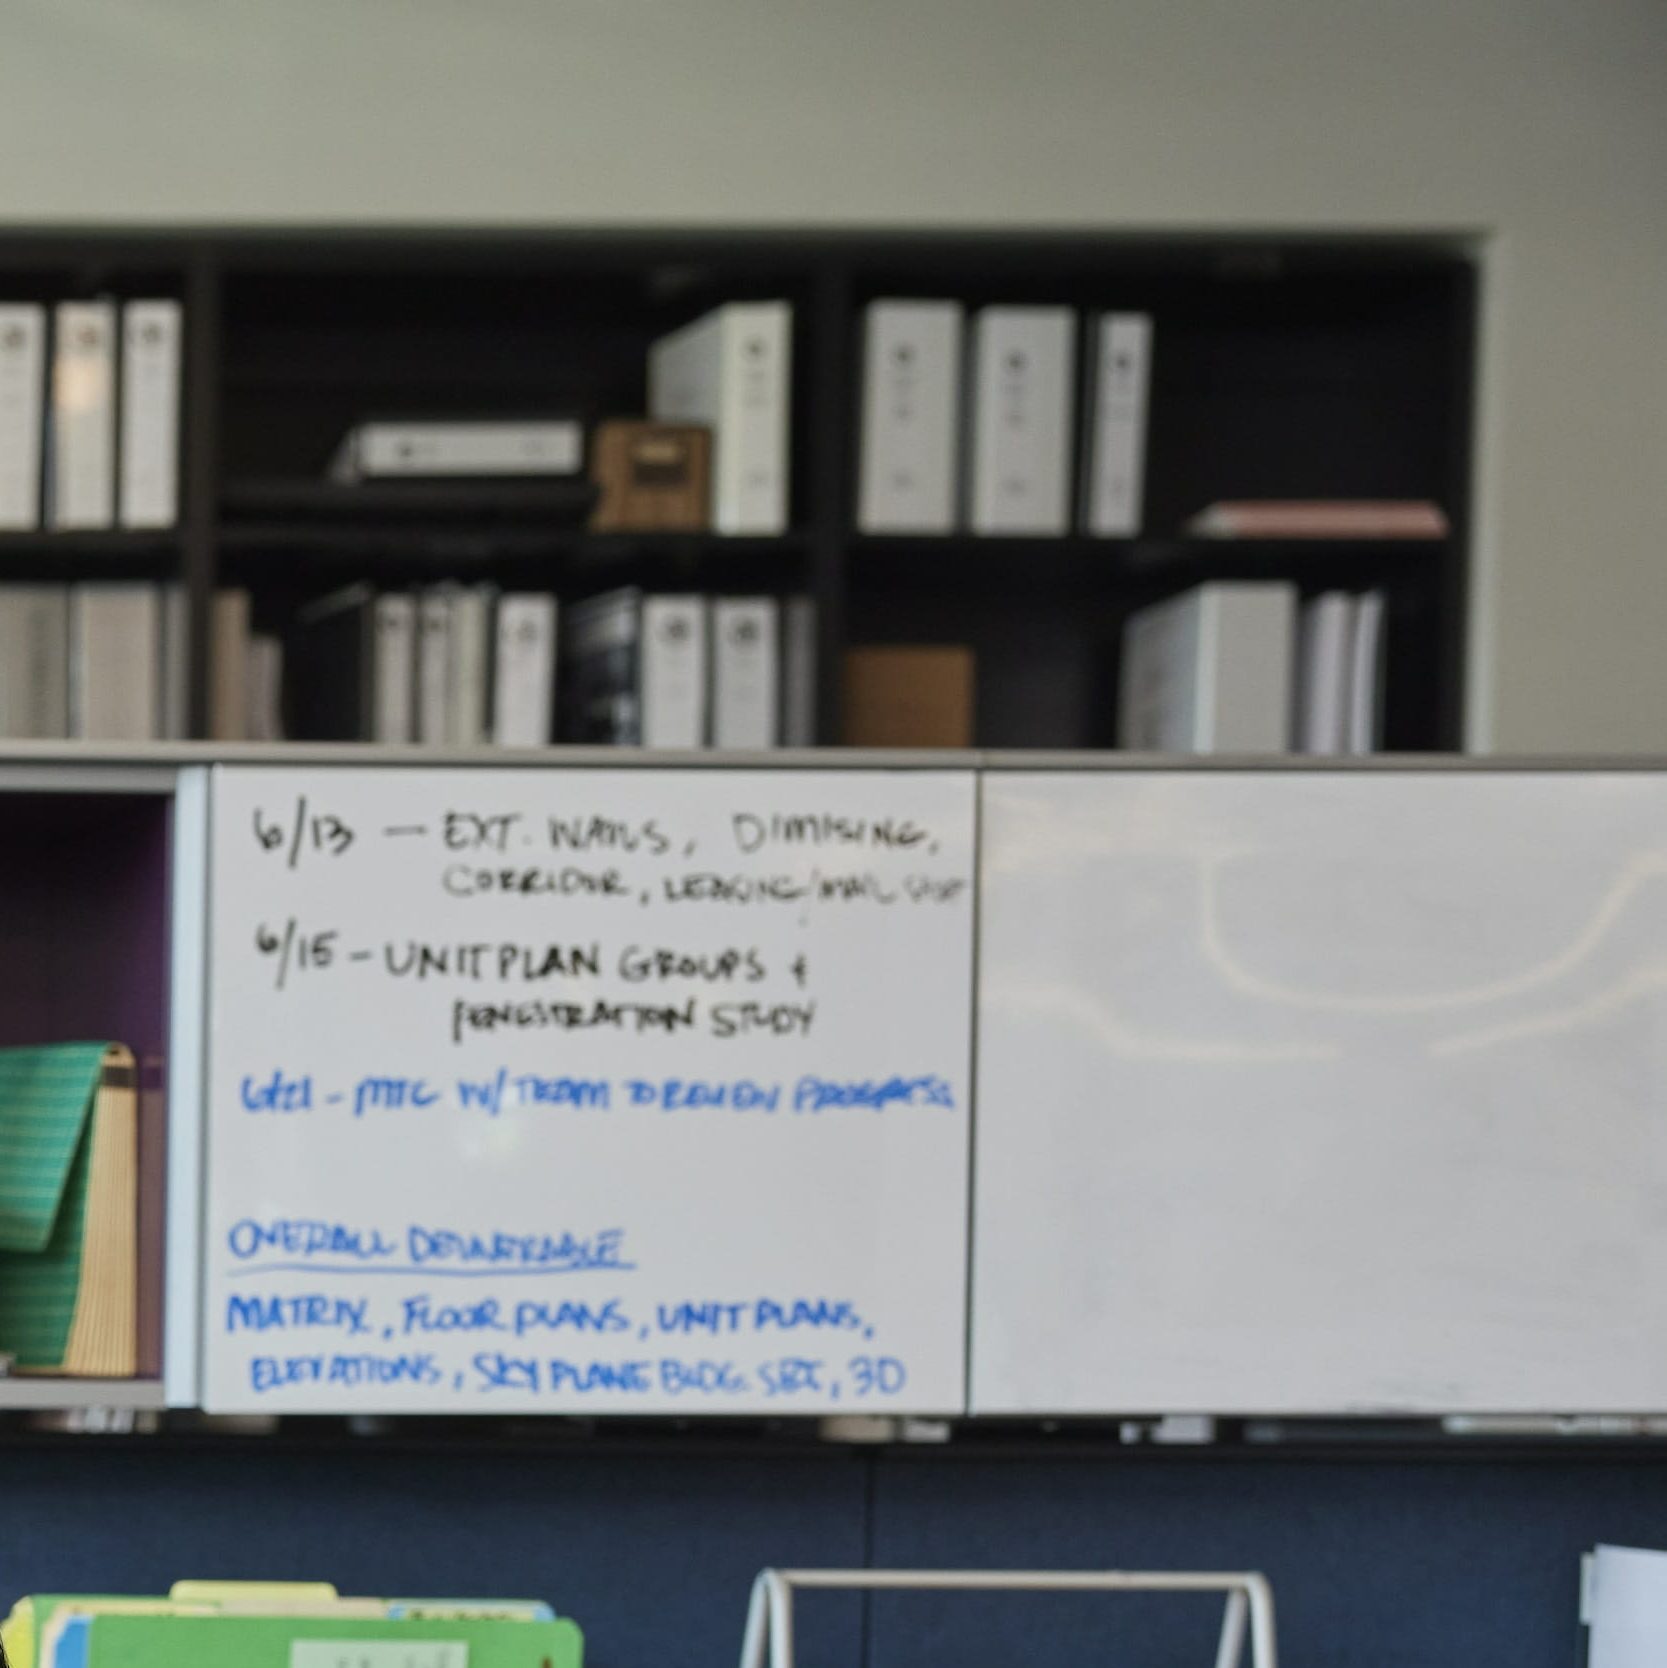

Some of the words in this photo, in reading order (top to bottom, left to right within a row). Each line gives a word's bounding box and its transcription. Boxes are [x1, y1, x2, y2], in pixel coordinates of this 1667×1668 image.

[253, 794, 356, 870] 6/13
[254, 917, 339, 990] 6/15
[497, 941, 602, 983] PLAN
[618, 944, 767, 984] GROUPS
[708, 999, 817, 1039] STUDY
[402, 1294, 508, 1336] FLOOR
[656, 1300, 751, 1337] UNIT
